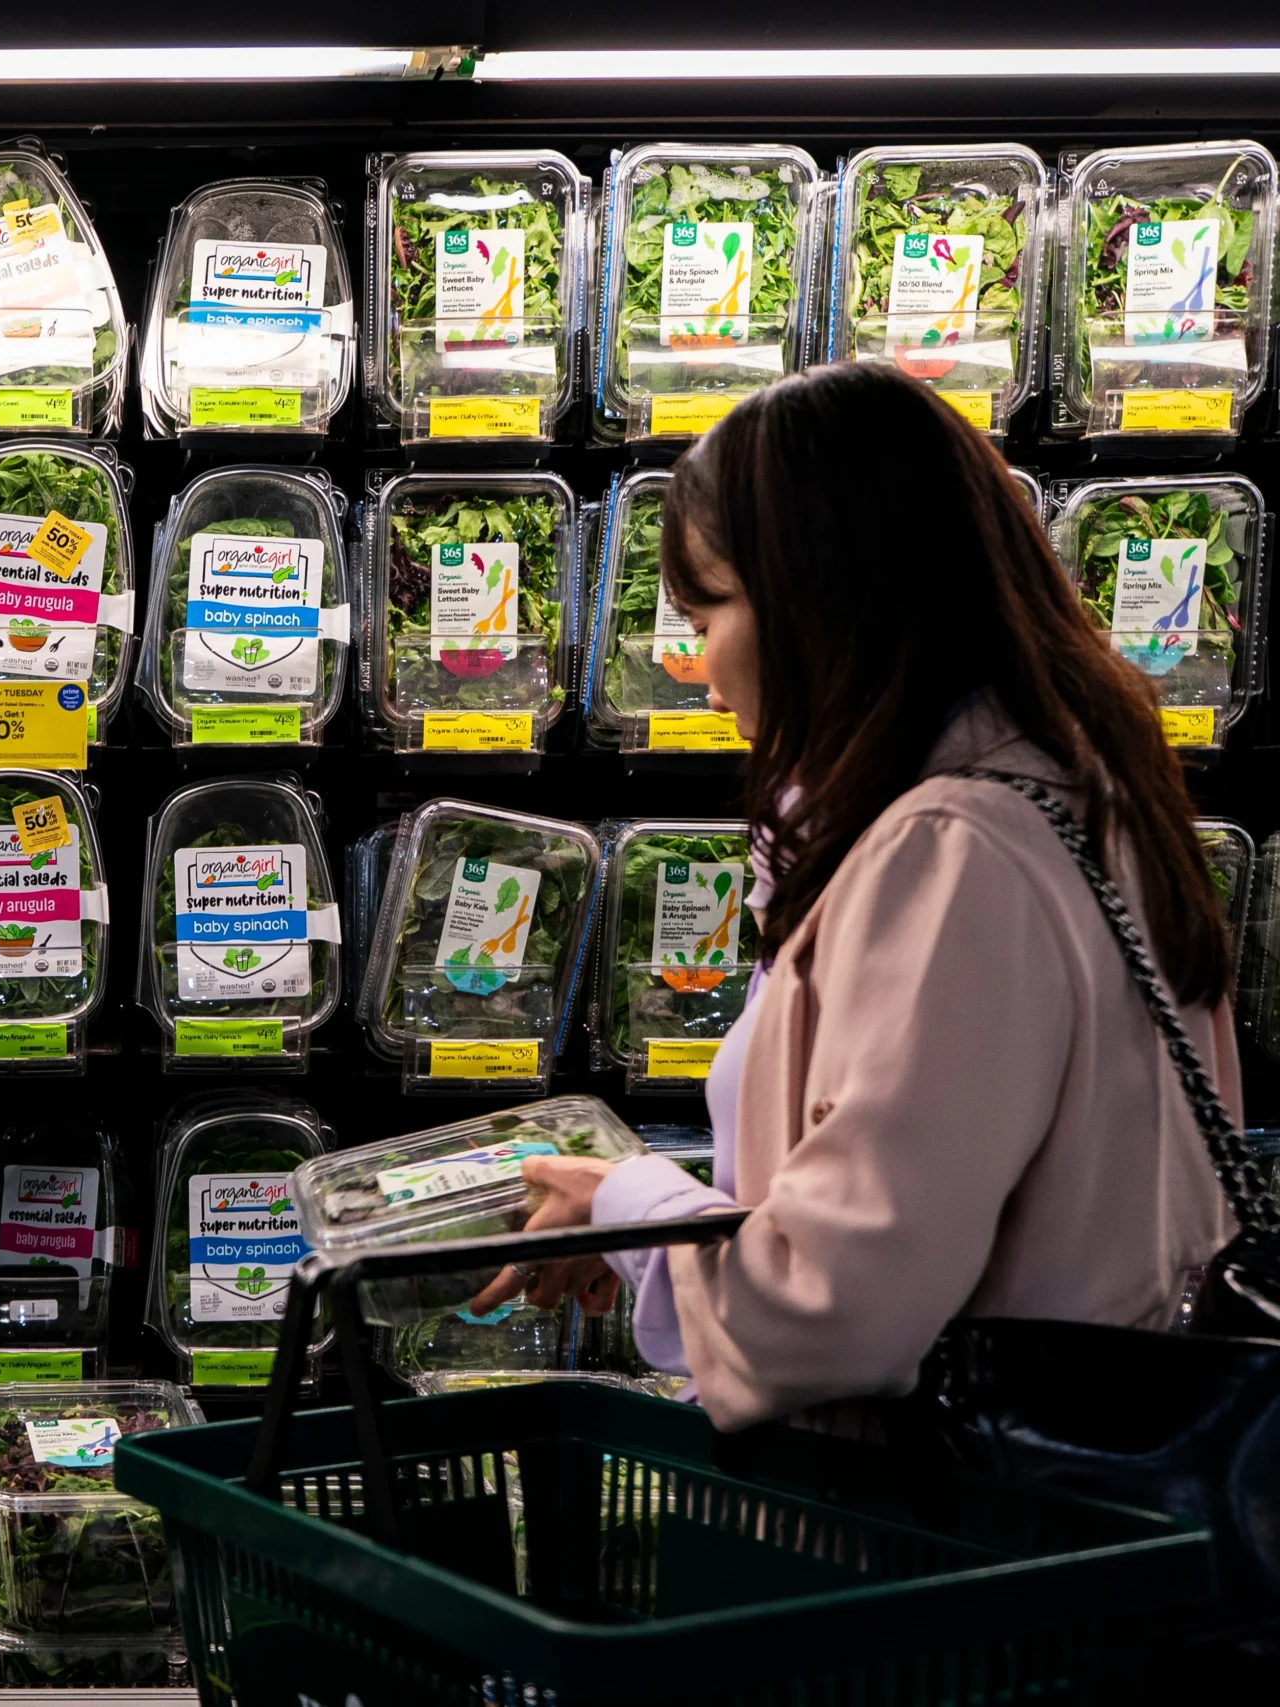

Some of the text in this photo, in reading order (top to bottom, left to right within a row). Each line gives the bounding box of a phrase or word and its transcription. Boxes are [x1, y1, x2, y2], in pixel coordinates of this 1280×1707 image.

[673, 225, 695, 240] 365
[446, 234, 466, 247] 365
[220, 254, 296, 274] organicgirl
[669, 267, 719, 277] Baby Spinach
[1134, 266, 1174, 277] Spring Mix
[442, 276, 484, 284] Sweet Baby
[669, 276, 705, 285] & Arugula
[898, 279, 943, 288] 50/50 Blend
[202, 285, 303, 301] super nutrition
[442, 284, 473, 292] Lettuces
[46, 527, 78, 550] 50%
[442, 547, 462, 559] 365
[1129, 542, 1149, 555] 365
[217, 546, 292, 572] organicgirl
[438, 573, 462, 581] Organic
[200, 584, 300, 600] super nutrition
[1122, 581, 1162, 591] Spring Mix
[24, 595, 73, 611] arugula
[204, 608, 300, 627] baby spinach
[4, 689, 44, 698] TUESDAY
[23, 872, 67, 887] salads
[9, 898, 56, 915] arugula
[455, 900, 489, 912] Baby Kale
[194, 917, 289, 935] baby spinach
[9, 1208, 88, 1226] essential salads
[206, 1240, 300, 1259] baby spinach
